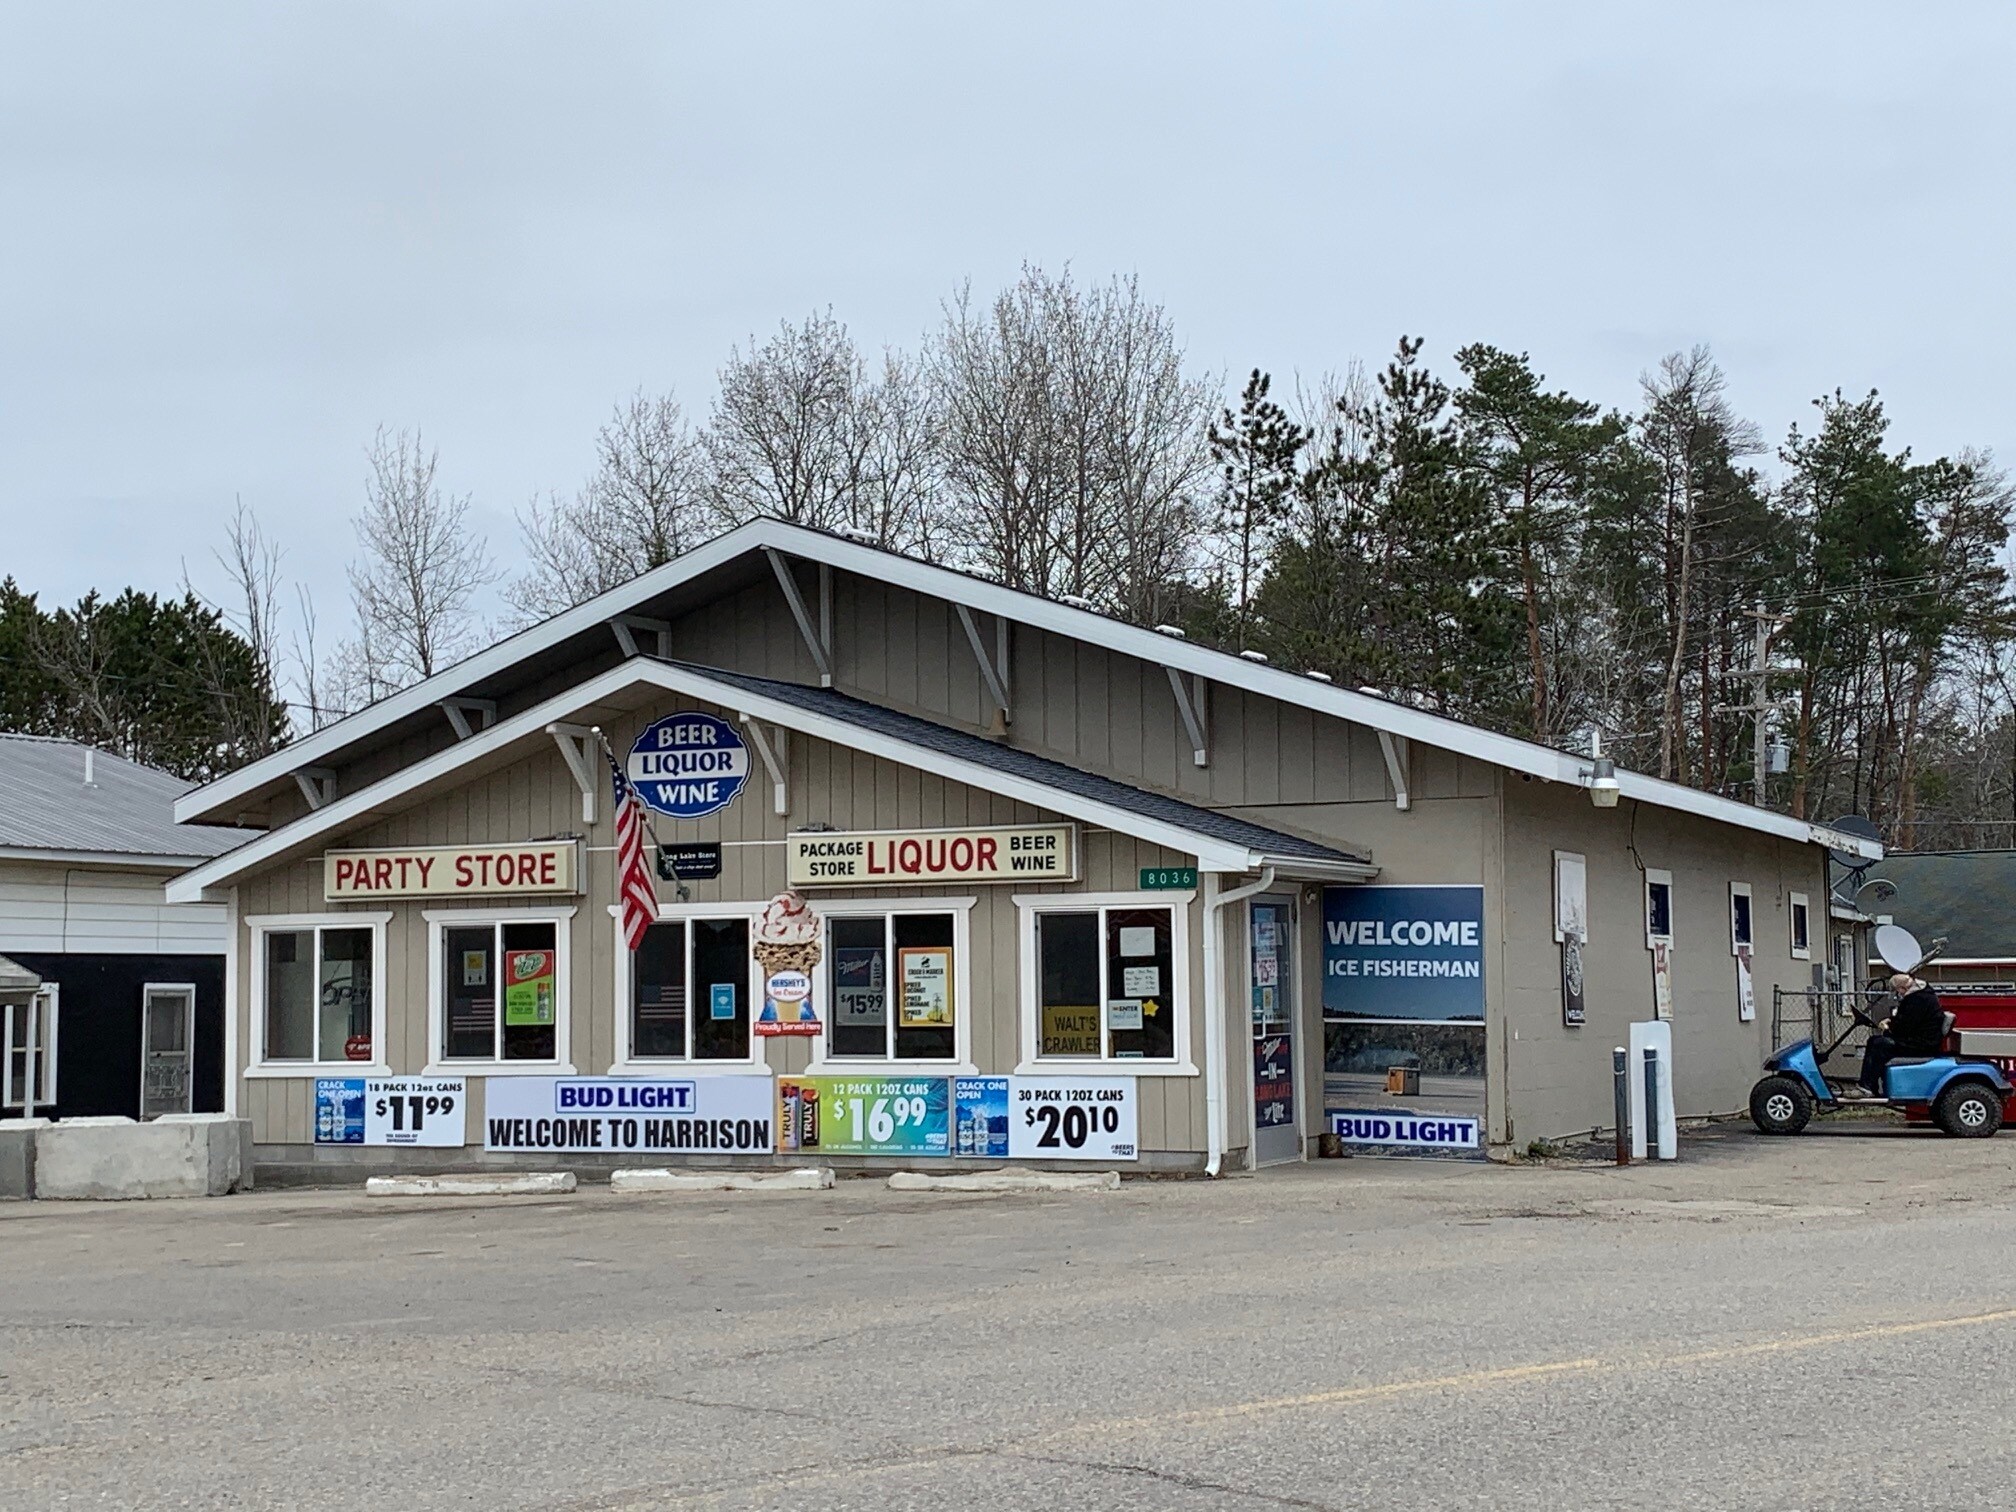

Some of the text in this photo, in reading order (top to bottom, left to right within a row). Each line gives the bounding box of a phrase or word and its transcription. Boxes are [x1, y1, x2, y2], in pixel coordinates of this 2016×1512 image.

[658, 724, 718, 748] BEER
[642, 751, 734, 777] LIQUOR
[657, 781, 719, 805] WINE
[800, 841, 863, 857] PACKAGE
[1010, 836, 1056, 850] BEER
[867, 838, 998, 875] LIQUOR
[1011, 856, 1056, 870] WINE
[336, 852, 556, 890] PARTY STORE
[810, 861, 855, 876] STORE
[1148, 872, 1190, 884] 8036
[1327, 920, 1478, 946] WELCOME
[1329, 960, 1479, 978] ICE FISHERMAN
[772, 979, 805, 987] HERSHEY'S
[1055, 1016, 1096, 1031] WALT'S
[318, 1081, 345, 1089] CRACK
[369, 1083, 380, 1091] 18
[383, 1083, 407, 1091] PACK
[437, 1083, 462, 1092] CANS
[833, 1084, 845, 1095] 12
[847, 1084, 874, 1095] PACK
[903, 1083, 929, 1095] CANS
[956, 1082, 1007, 1090] CRACK ONE
[560, 1087, 690, 1108] BUD LIGHT
[957, 1091, 981, 1099] OPEN
[1019, 1090, 1031, 1101] 30
[1035, 1090, 1062, 1101] PACK
[1097, 1090, 1123, 1101] CANS
[783, 1100, 791, 1138] TRULY
[803, 1102, 814, 1140] TRULY
[489, 1119, 769, 1149] WELCOME TO HARRISON
[1336, 1118, 1473, 1143] BUD LIGHT
